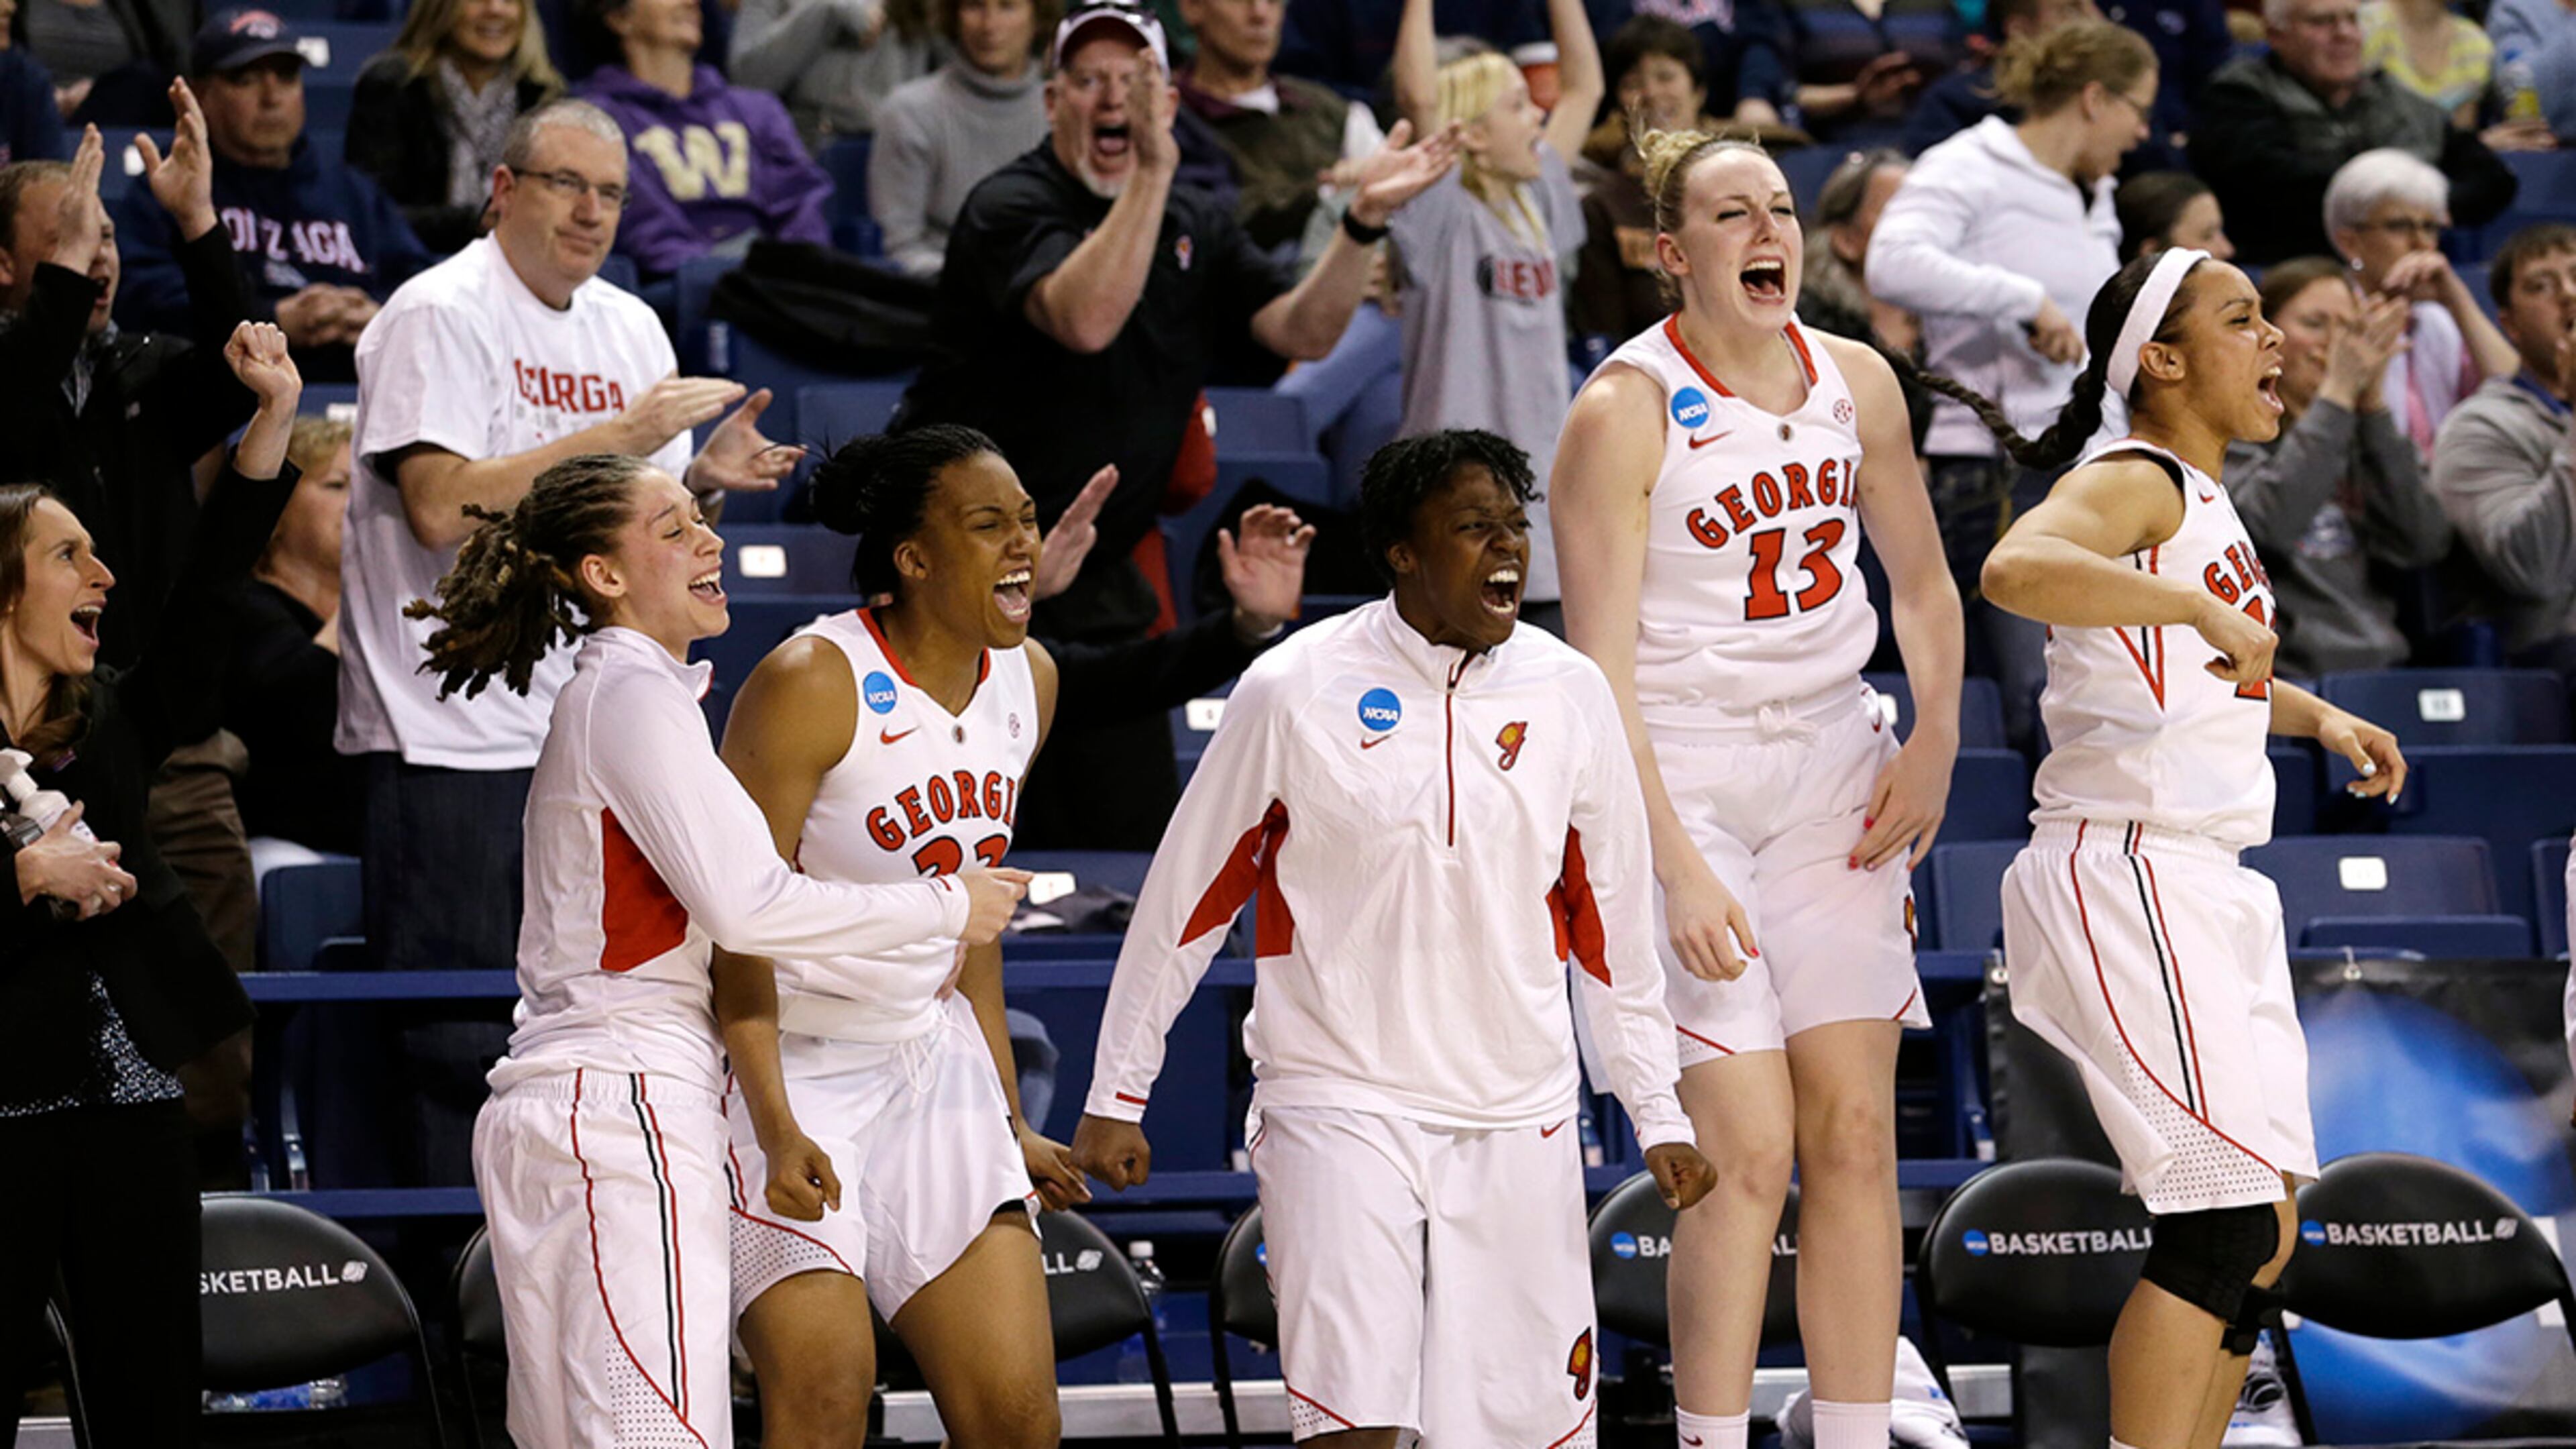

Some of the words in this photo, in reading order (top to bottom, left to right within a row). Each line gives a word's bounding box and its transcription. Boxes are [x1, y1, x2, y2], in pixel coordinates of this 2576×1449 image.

[633, 121, 750, 201] W
[1678, 402, 1708, 421] NCAA
[1686, 458, 1856, 550] GEORGI
[1744, 517, 1846, 621] 13
[869, 690, 895, 704] NCAA
[1362, 706, 1399, 722] NCAA
[866, 769, 1016, 853] GEORGI
[2326, 1220, 2492, 1246] BASKETBALL
[199, 1263, 339, 1295] SKETBALL
